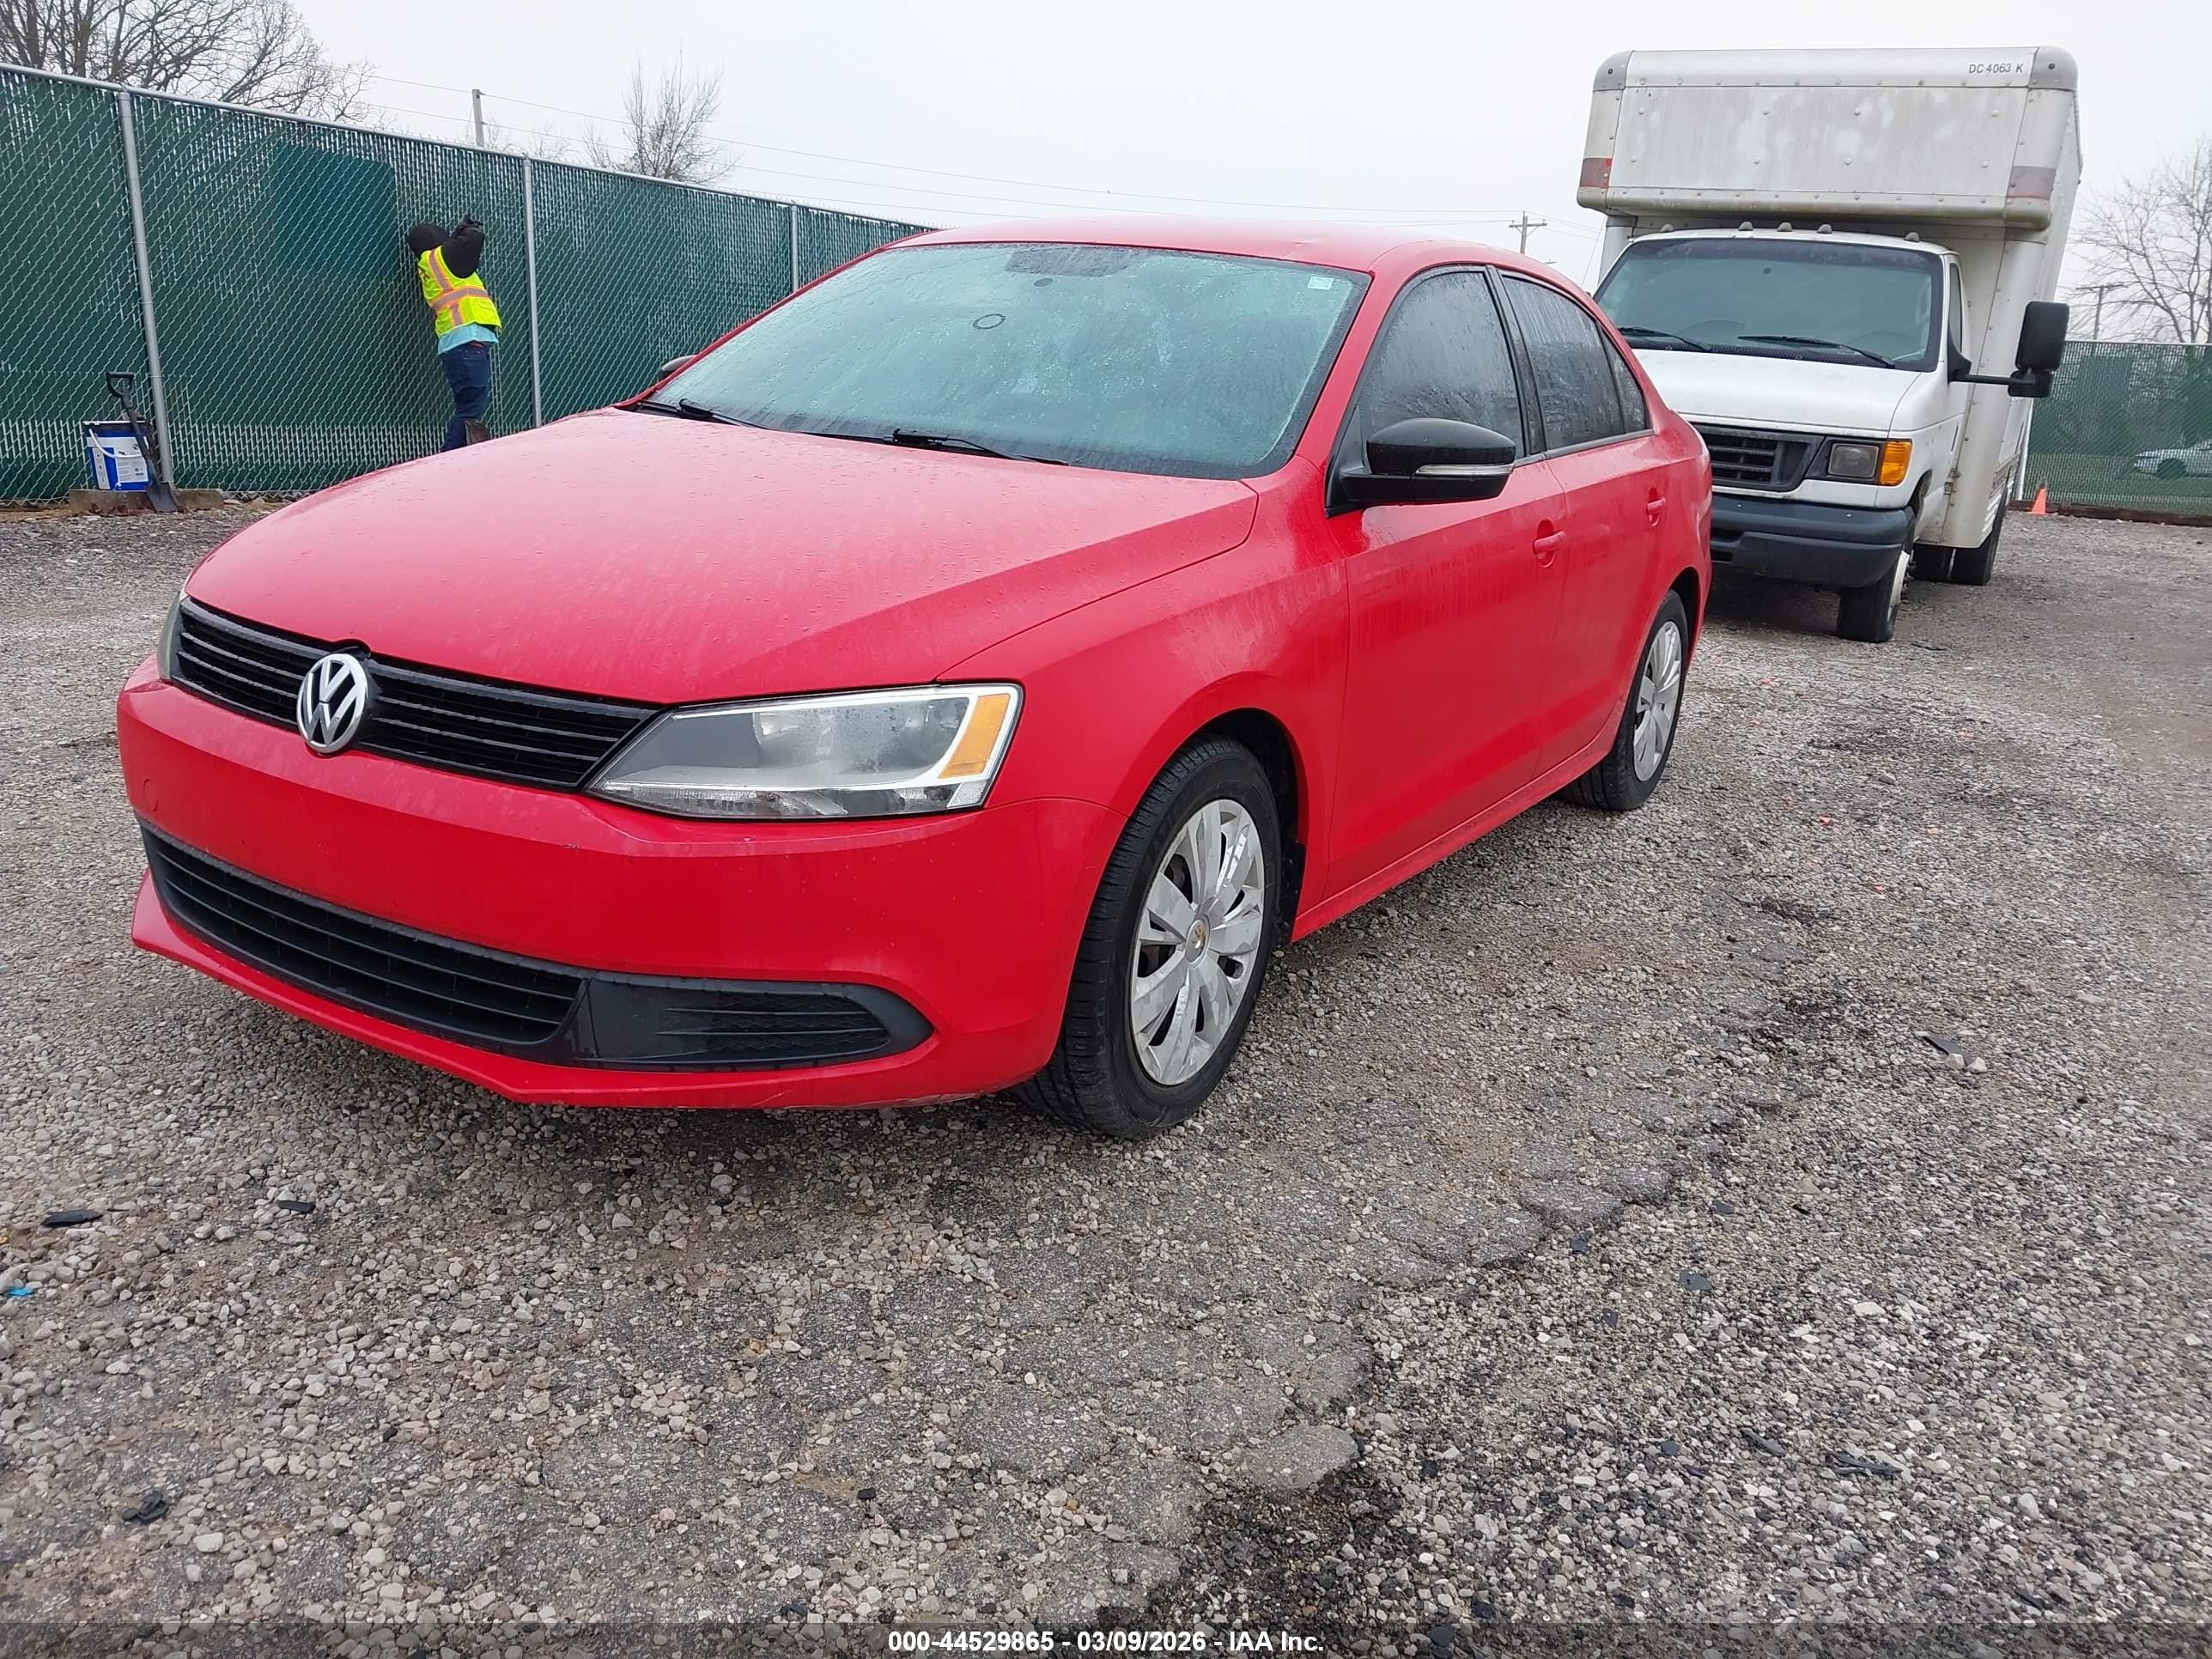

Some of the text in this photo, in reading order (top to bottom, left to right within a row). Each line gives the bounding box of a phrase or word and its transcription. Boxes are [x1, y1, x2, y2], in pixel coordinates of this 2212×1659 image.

[1969, 63, 2025, 74] DC 4063 K
